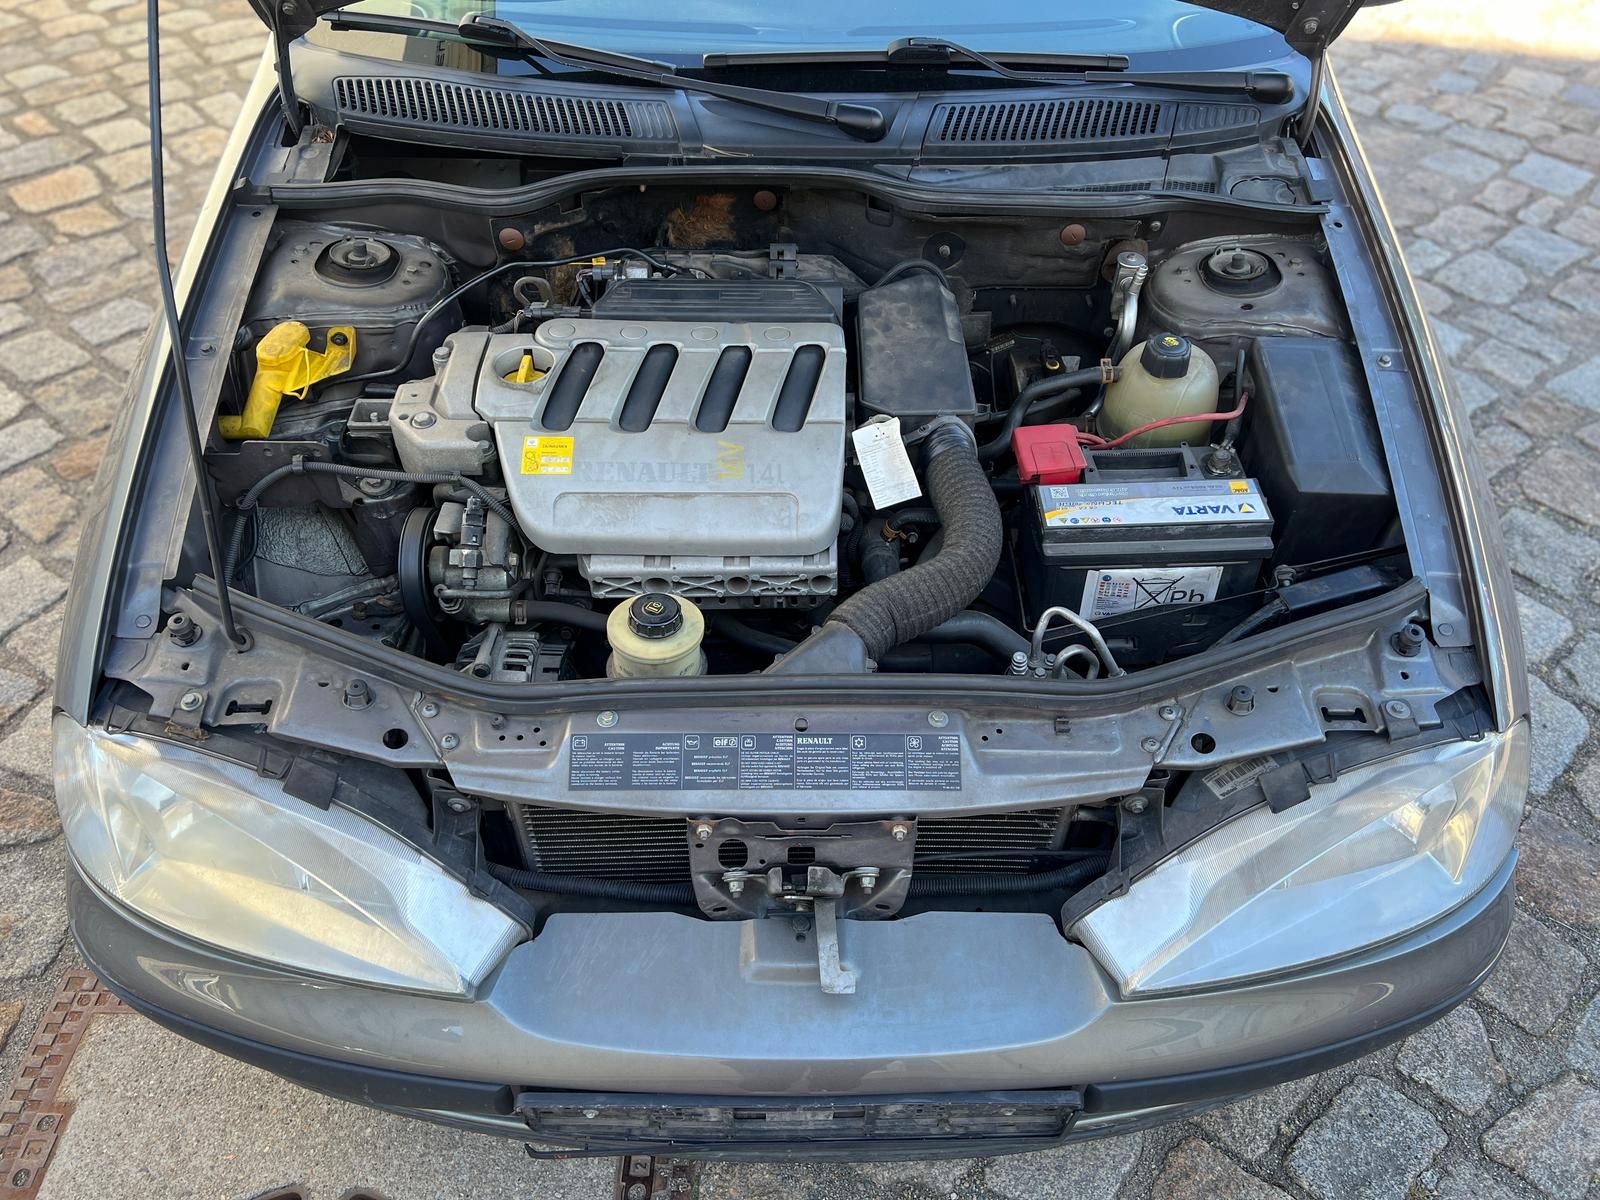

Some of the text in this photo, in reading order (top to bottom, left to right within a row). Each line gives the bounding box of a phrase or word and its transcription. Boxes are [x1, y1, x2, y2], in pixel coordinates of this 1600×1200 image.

[716, 439, 746, 481] 16V
[1172, 505, 1235, 515] VARTA
[715, 738, 729, 746] elf
[797, 737, 833, 745] RENAULT
